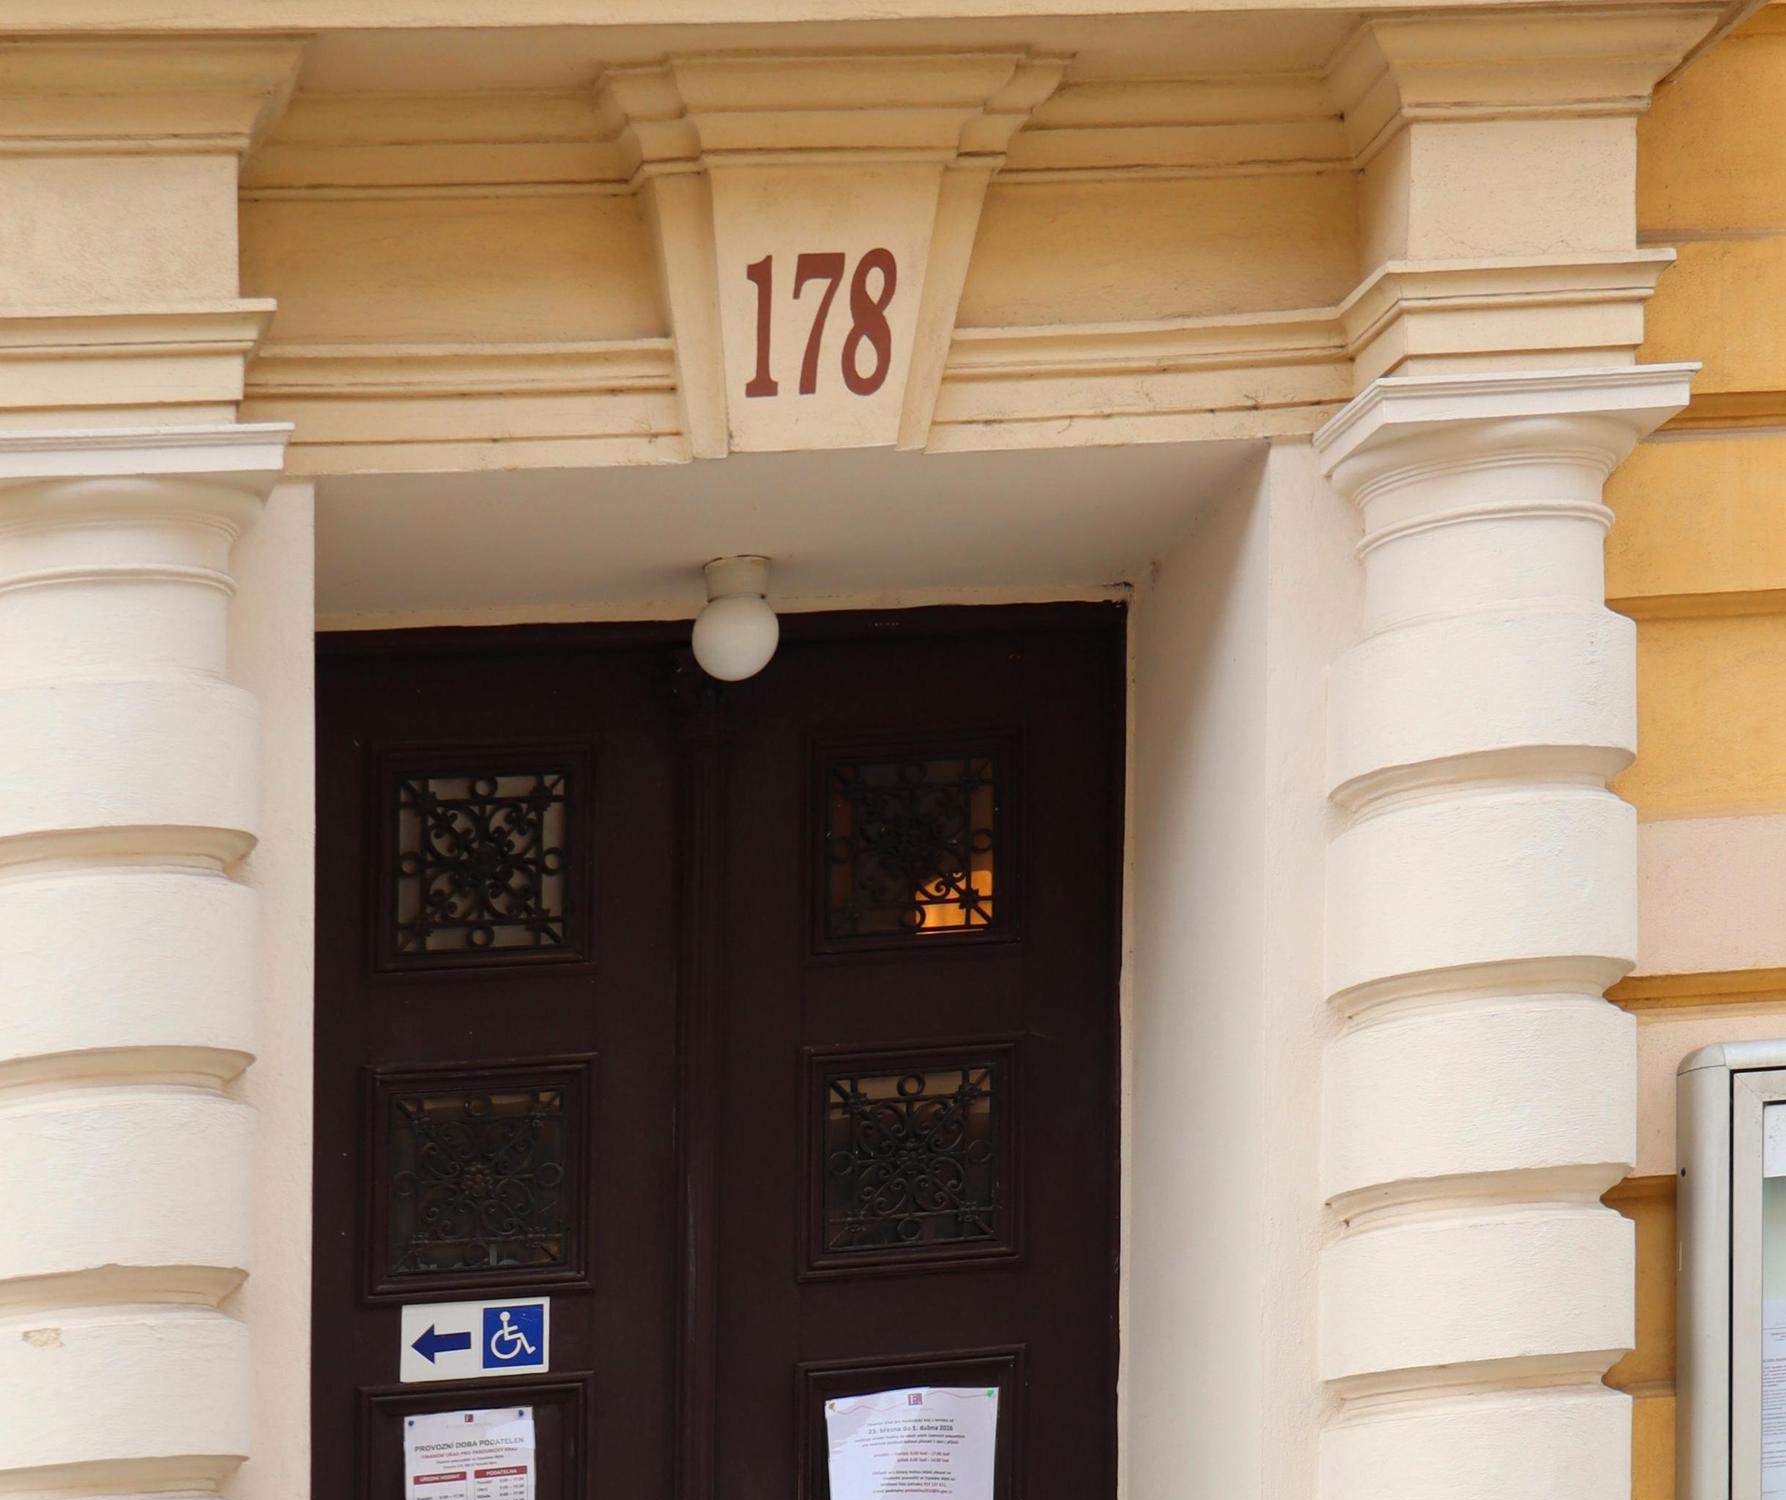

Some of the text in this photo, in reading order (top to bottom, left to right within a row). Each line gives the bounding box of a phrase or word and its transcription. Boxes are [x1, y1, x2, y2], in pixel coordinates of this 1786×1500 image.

[745, 247, 898, 398] 178
[414, 1442, 453, 1452] PROVOZNÍ
[455, 1440, 478, 1449] DOBA
